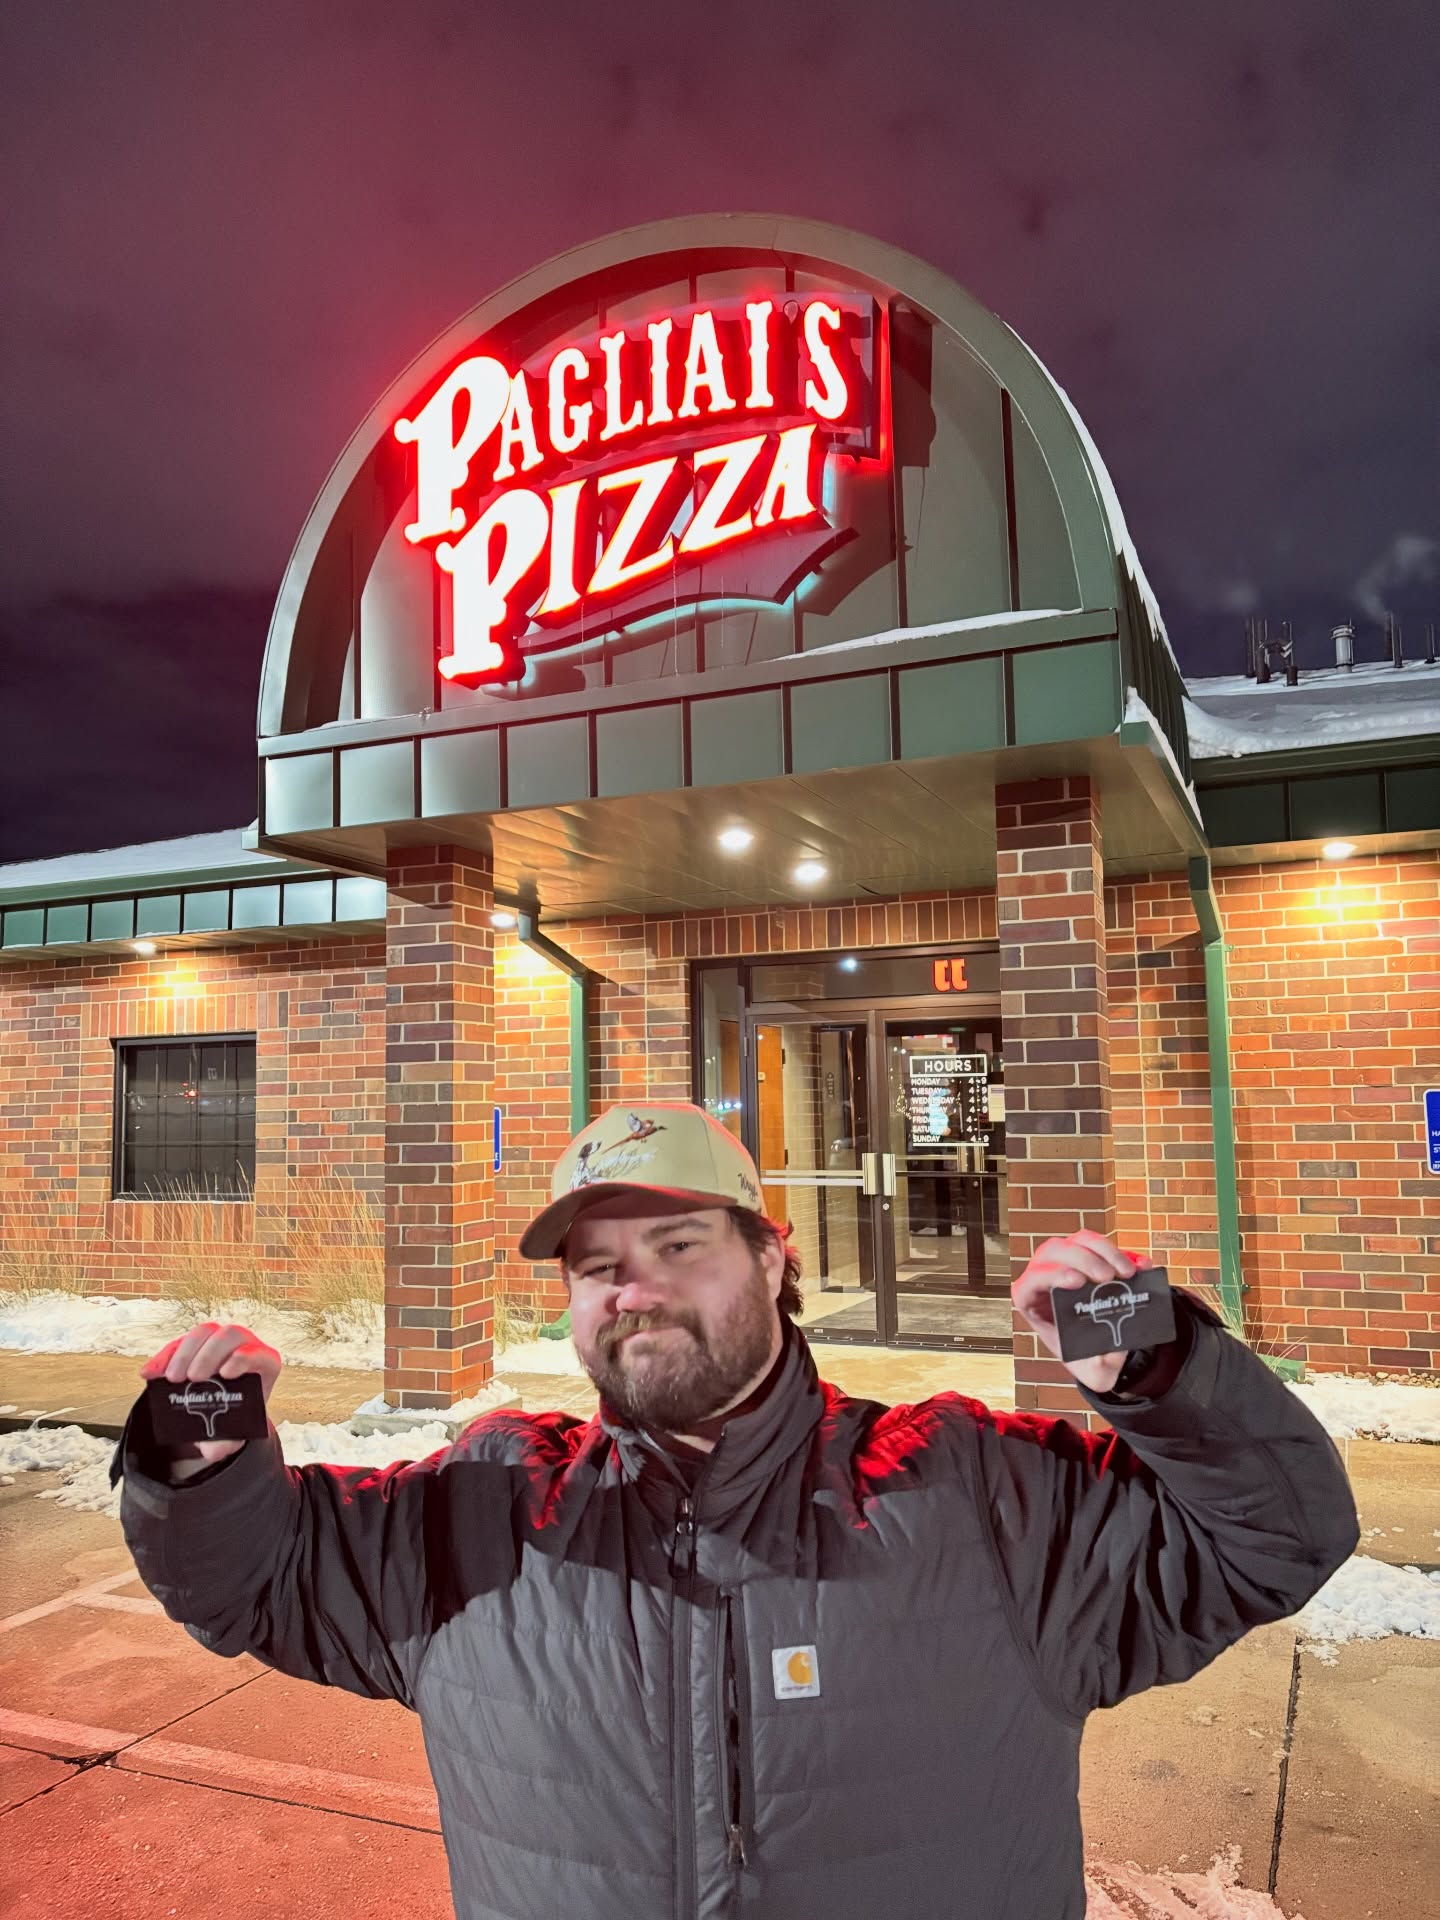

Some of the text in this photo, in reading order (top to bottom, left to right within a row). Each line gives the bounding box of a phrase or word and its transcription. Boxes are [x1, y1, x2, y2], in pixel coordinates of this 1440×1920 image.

[394, 300, 848, 544] PAGLIAI'S
[436, 423, 816, 680] PIZZA
[924, 1060, 972, 1072] HOURS
[911, 1078, 941, 1086] MONDAY
[911, 1087, 942, 1095] TUESDAY
[911, 1097, 955, 1105] WEDDAY
[969, 1096, 975, 1104] 4
[911, 1106, 948, 1114] THUAY
[913, 1134, 941, 1142] SUNDAY
